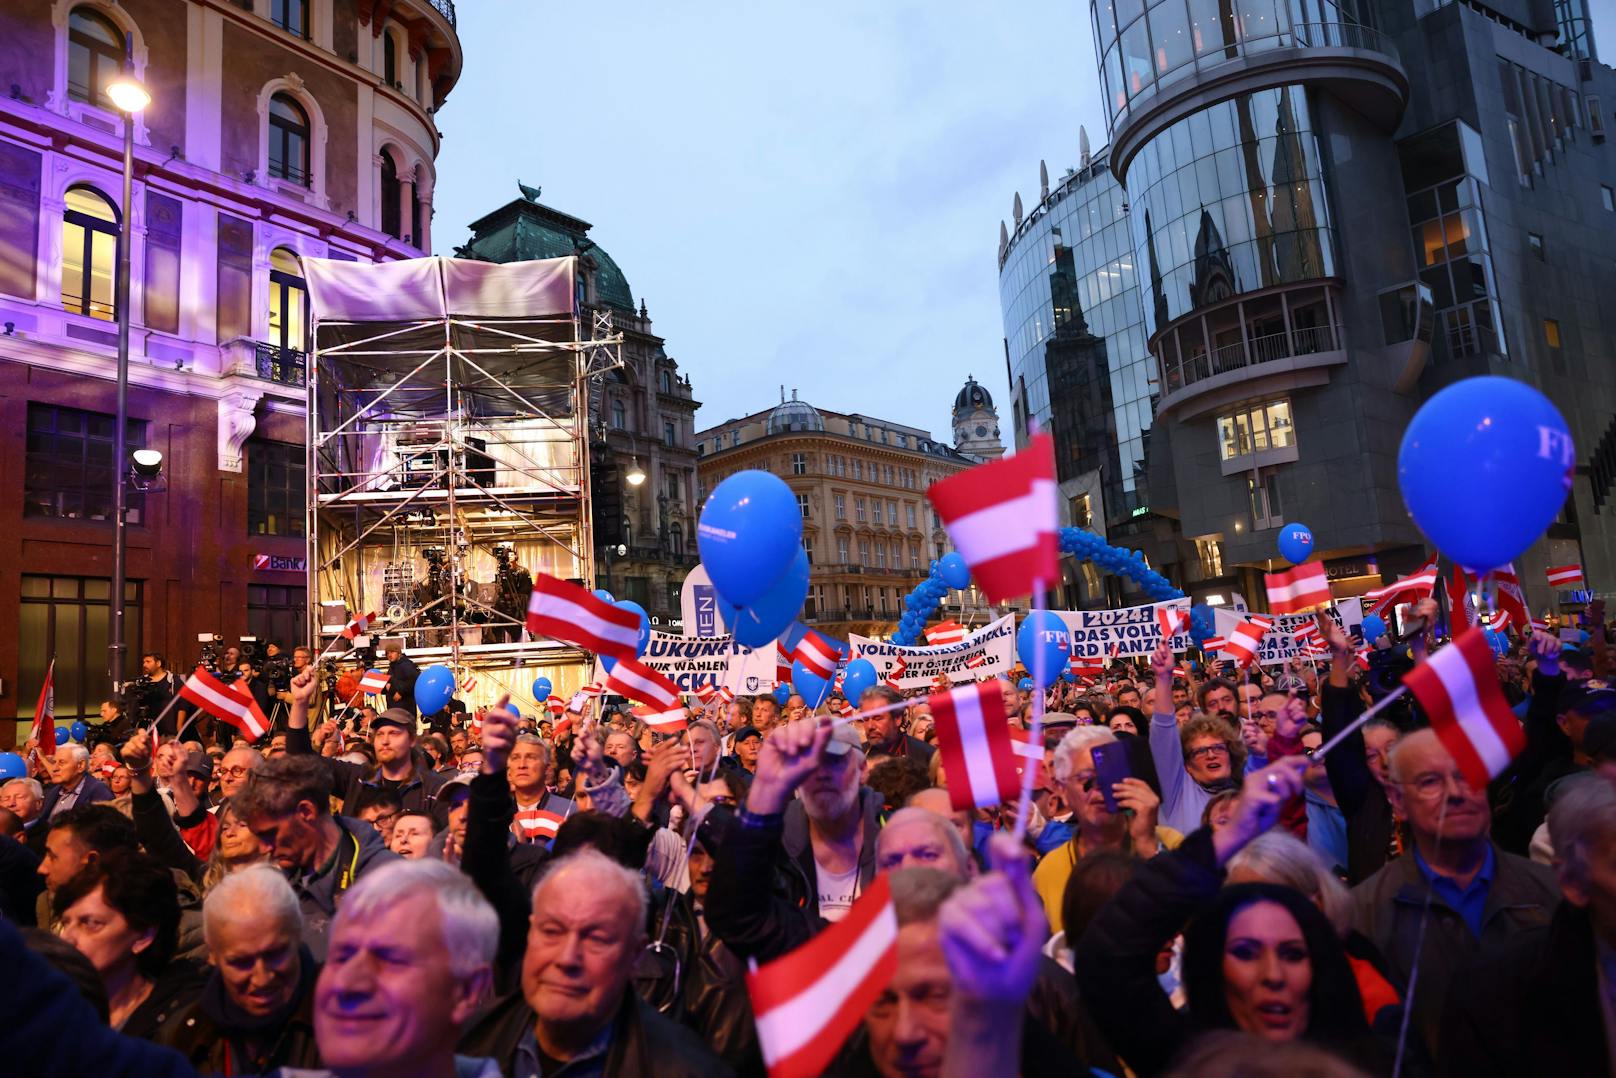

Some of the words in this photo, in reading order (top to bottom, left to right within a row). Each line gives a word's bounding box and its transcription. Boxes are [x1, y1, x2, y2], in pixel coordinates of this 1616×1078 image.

[271, 555, 300, 569] Bank
[1326, 562, 1360, 577] OTEL
[699, 596, 714, 638] IEN
[1087, 610, 1150, 626] 2024:
[1074, 627, 1110, 642] DAS
[1114, 624, 1163, 639] VOLK
[674, 659, 730, 671] WÄHLEN
